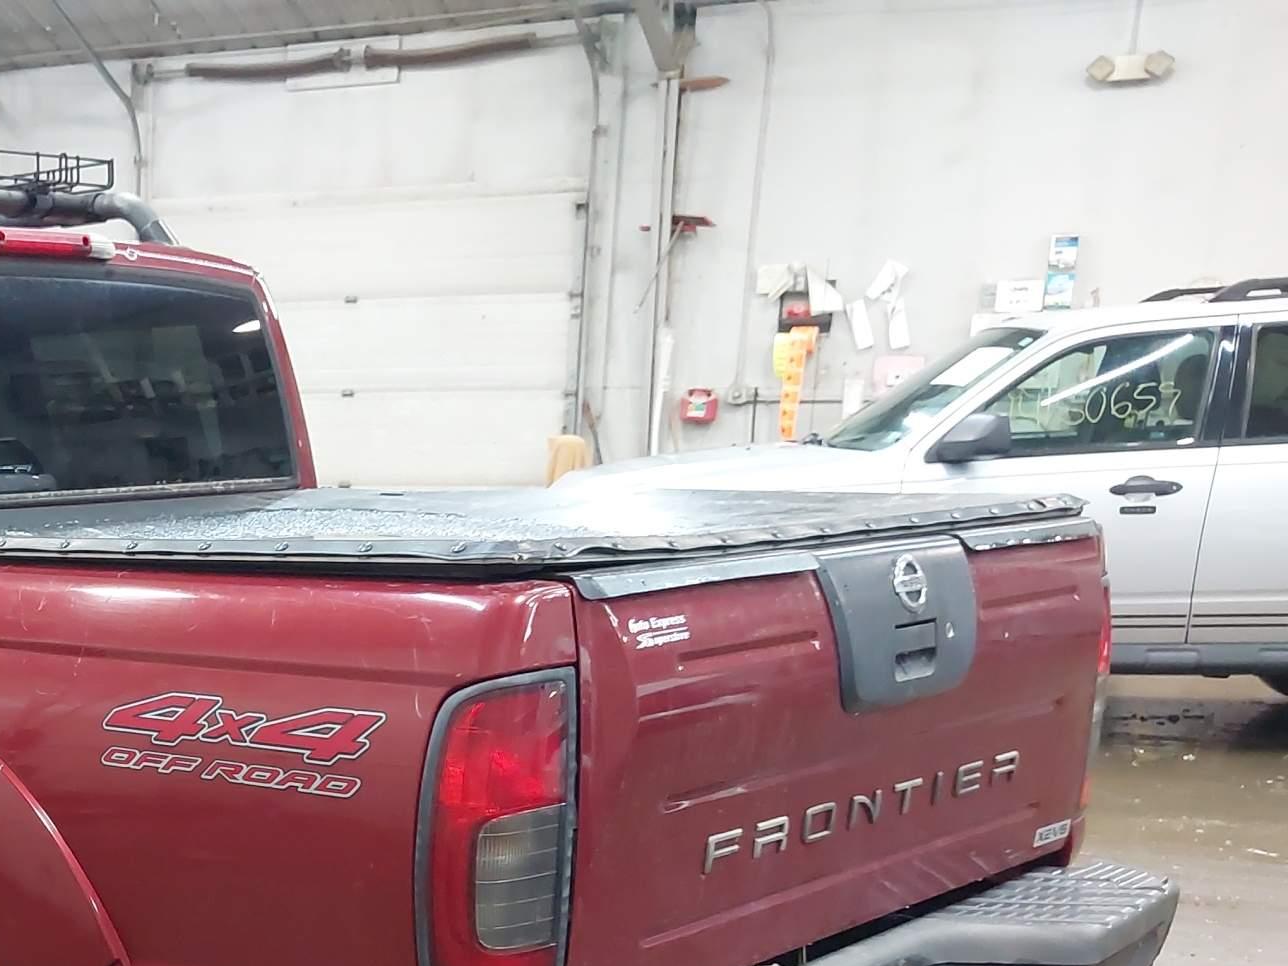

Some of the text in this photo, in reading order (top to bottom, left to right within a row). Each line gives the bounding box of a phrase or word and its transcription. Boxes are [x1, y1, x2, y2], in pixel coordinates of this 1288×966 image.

[102, 692, 387, 765] 4x4
[101, 746, 362, 798] OFF ROAD
[703, 750, 1020, 875] FRONTIER
